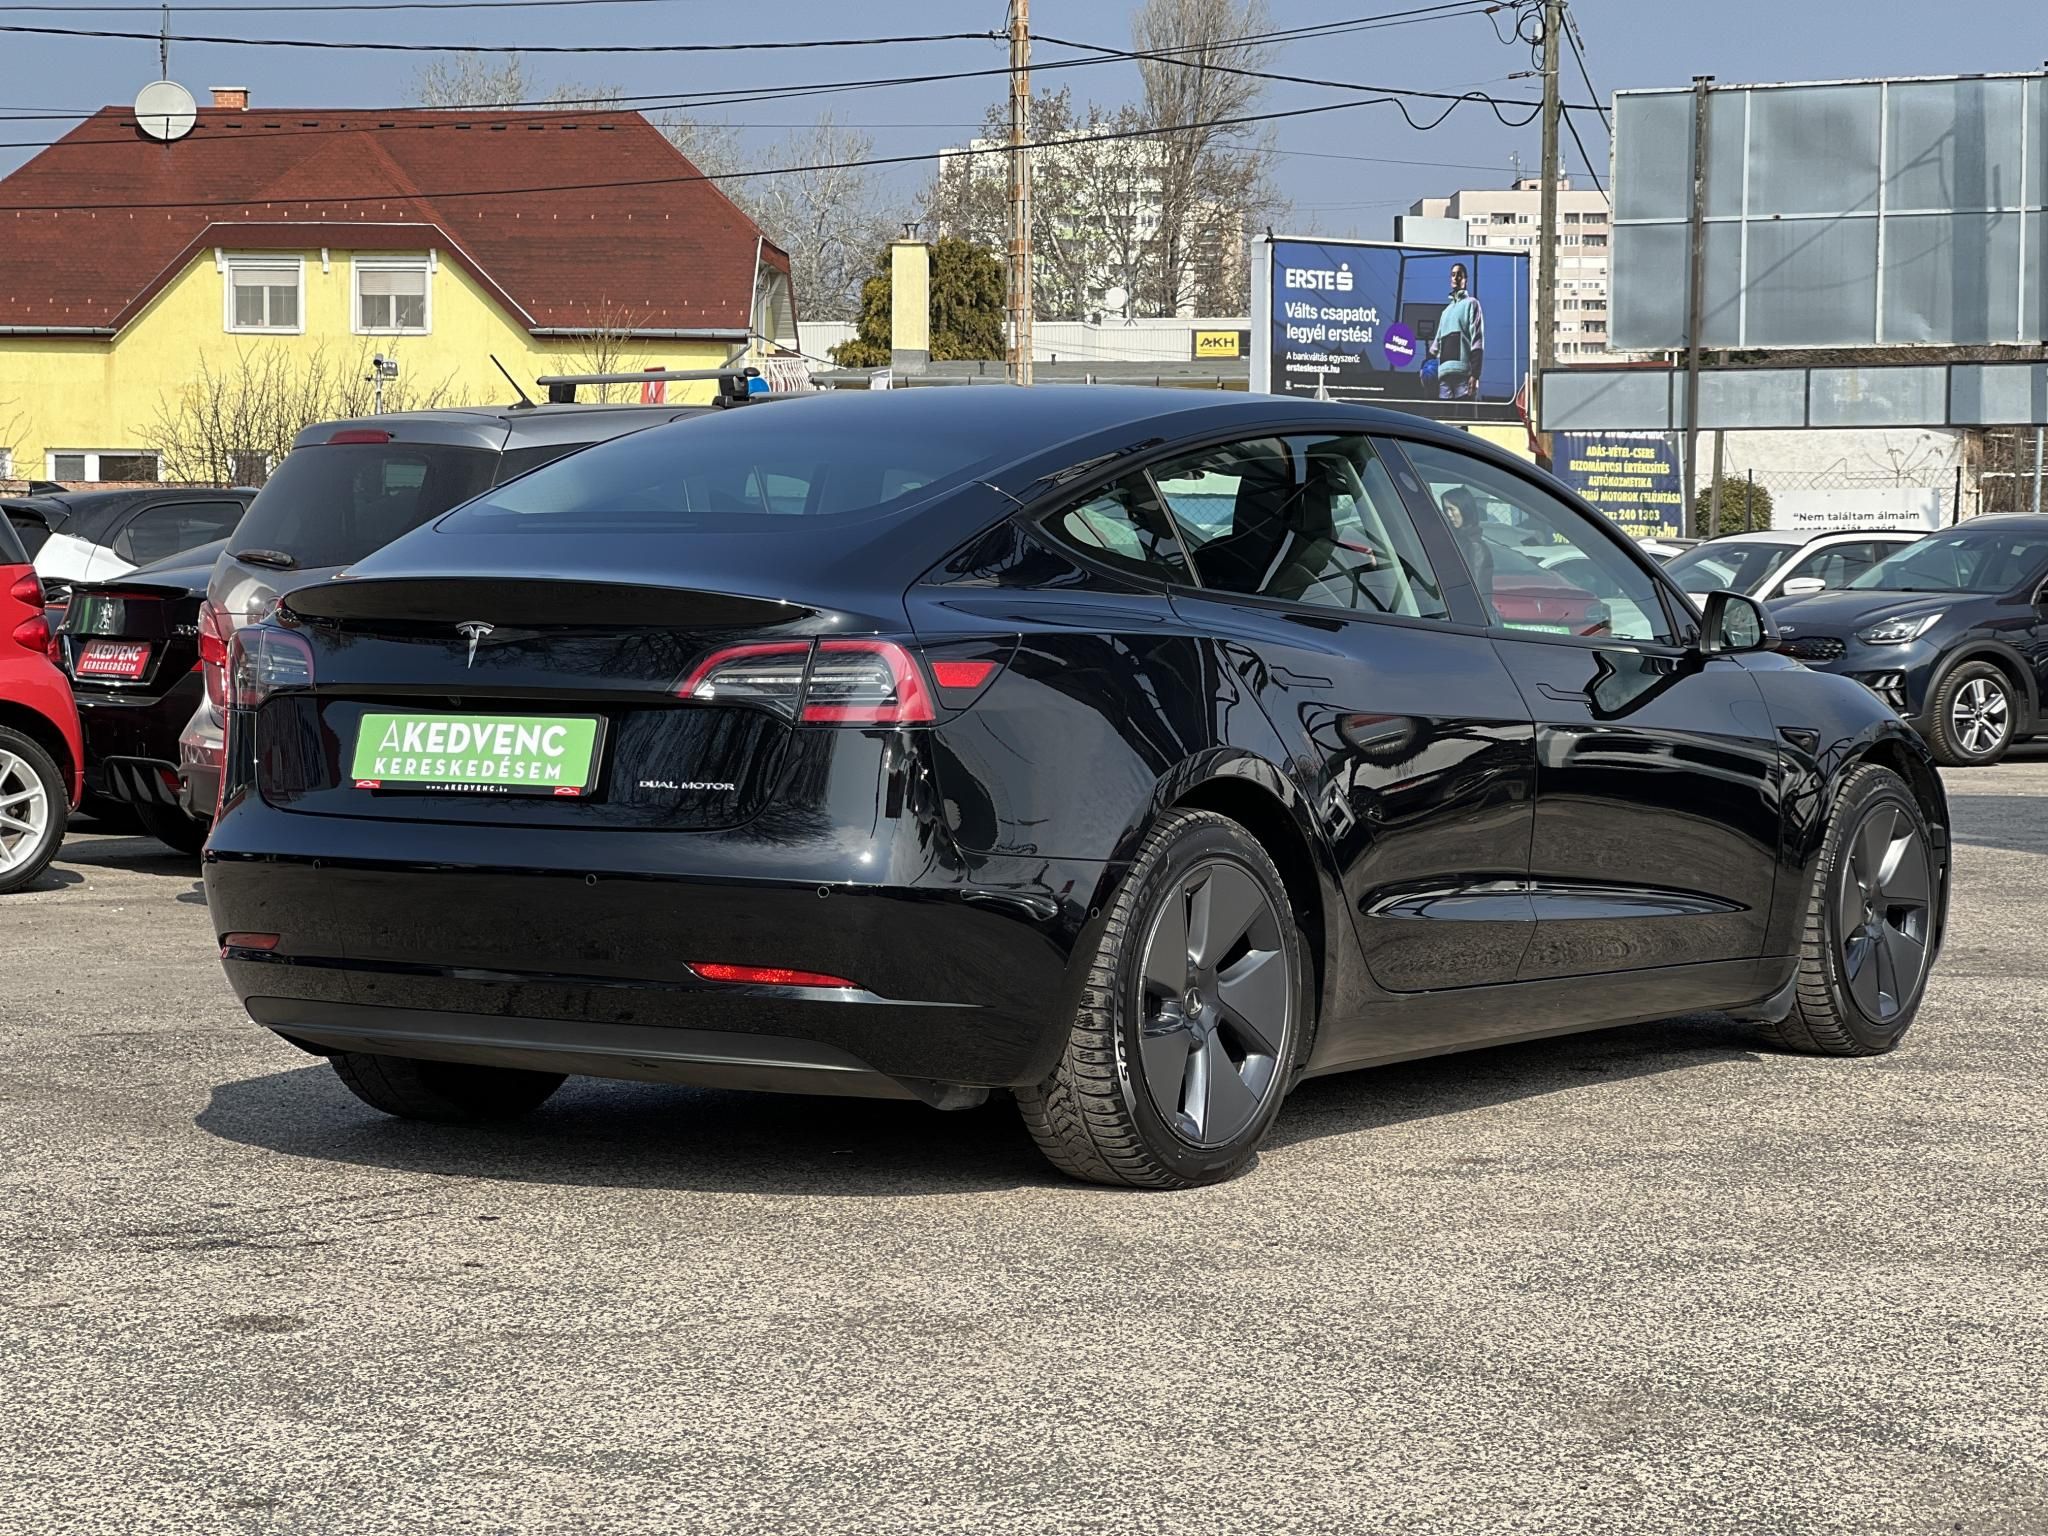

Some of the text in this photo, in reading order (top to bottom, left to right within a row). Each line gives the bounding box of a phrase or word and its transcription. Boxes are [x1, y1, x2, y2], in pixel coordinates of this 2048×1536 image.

[1285, 268, 1335, 290] ERSTE
[1285, 302, 1380, 325] Válts csapatot,
[1286, 323, 1372, 343] legyél erstés!
[1200, 337, 1235, 347] AKH
[1286, 352, 1293, 360] A
[1293, 352, 1328, 362] bankváltás
[1586, 444, 1655, 459] ADÁS-VÉTEL-CSERE
[1569, 460, 1622, 473] BIZOMÁNYOSI
[1588, 474, 1653, 488] AUTÓKOZMETIKA
[1600, 491, 1639, 502] MOTOROK
[1619, 508, 1636, 520] 240
[1638, 509, 1660, 520] 1303
[1828, 511, 1875, 521] találtam
[1878, 510, 1920, 520] álmaim
[87, 643, 142, 661] AKEDVENC
[83, 660, 137, 672] KERESKEDÉSEM
[378, 719, 567, 757] AKEDVENC
[374, 756, 562, 780] KERESKEDÉSEM
[639, 780, 735, 791] DUAL MOTOR
